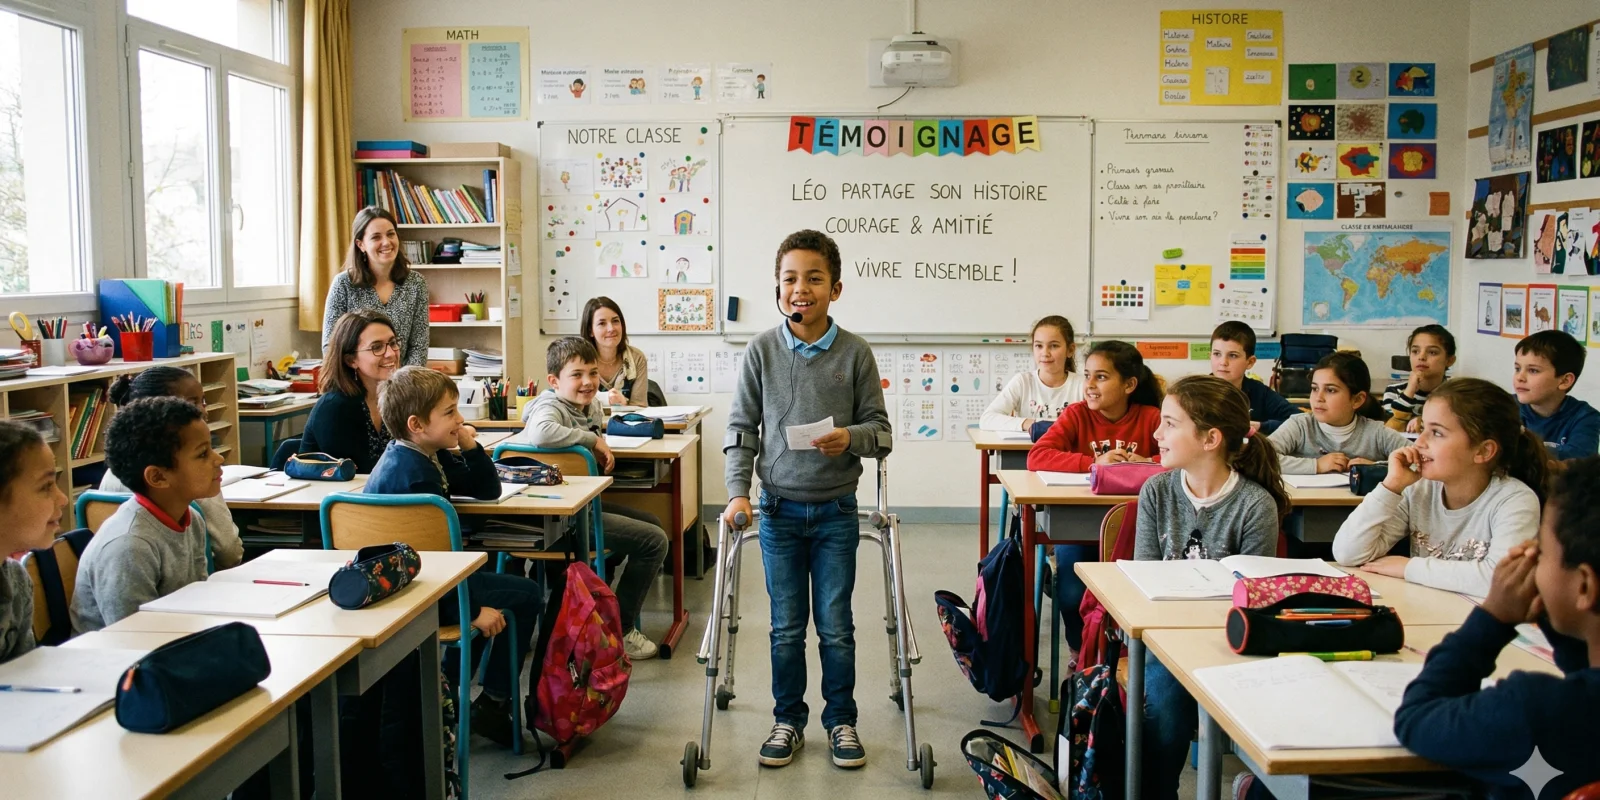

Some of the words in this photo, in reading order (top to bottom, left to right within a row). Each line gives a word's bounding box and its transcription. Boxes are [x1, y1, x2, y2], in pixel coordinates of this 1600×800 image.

[1192, 13, 1248, 25] HISTORE
[446, 30, 479, 40] MATH
[568, 128, 616, 144] NOTRE
[626, 128, 681, 144] CLASSE
[794, 121, 1035, 149] TÉMOIGNAGE
[792, 178, 827, 201] LÉO
[842, 183, 915, 200] PARTAGE
[930, 183, 962, 200] SON
[974, 181, 1048, 201] HISTOIRE
[825, 216, 900, 234] COURAGE
[911, 216, 923, 234] &
[932, 213, 993, 235] AMITIÉ
[855, 257, 902, 279] VIVRE
[915, 262, 1004, 282] ENSEMBLE
[1012, 257, 1018, 283] !
